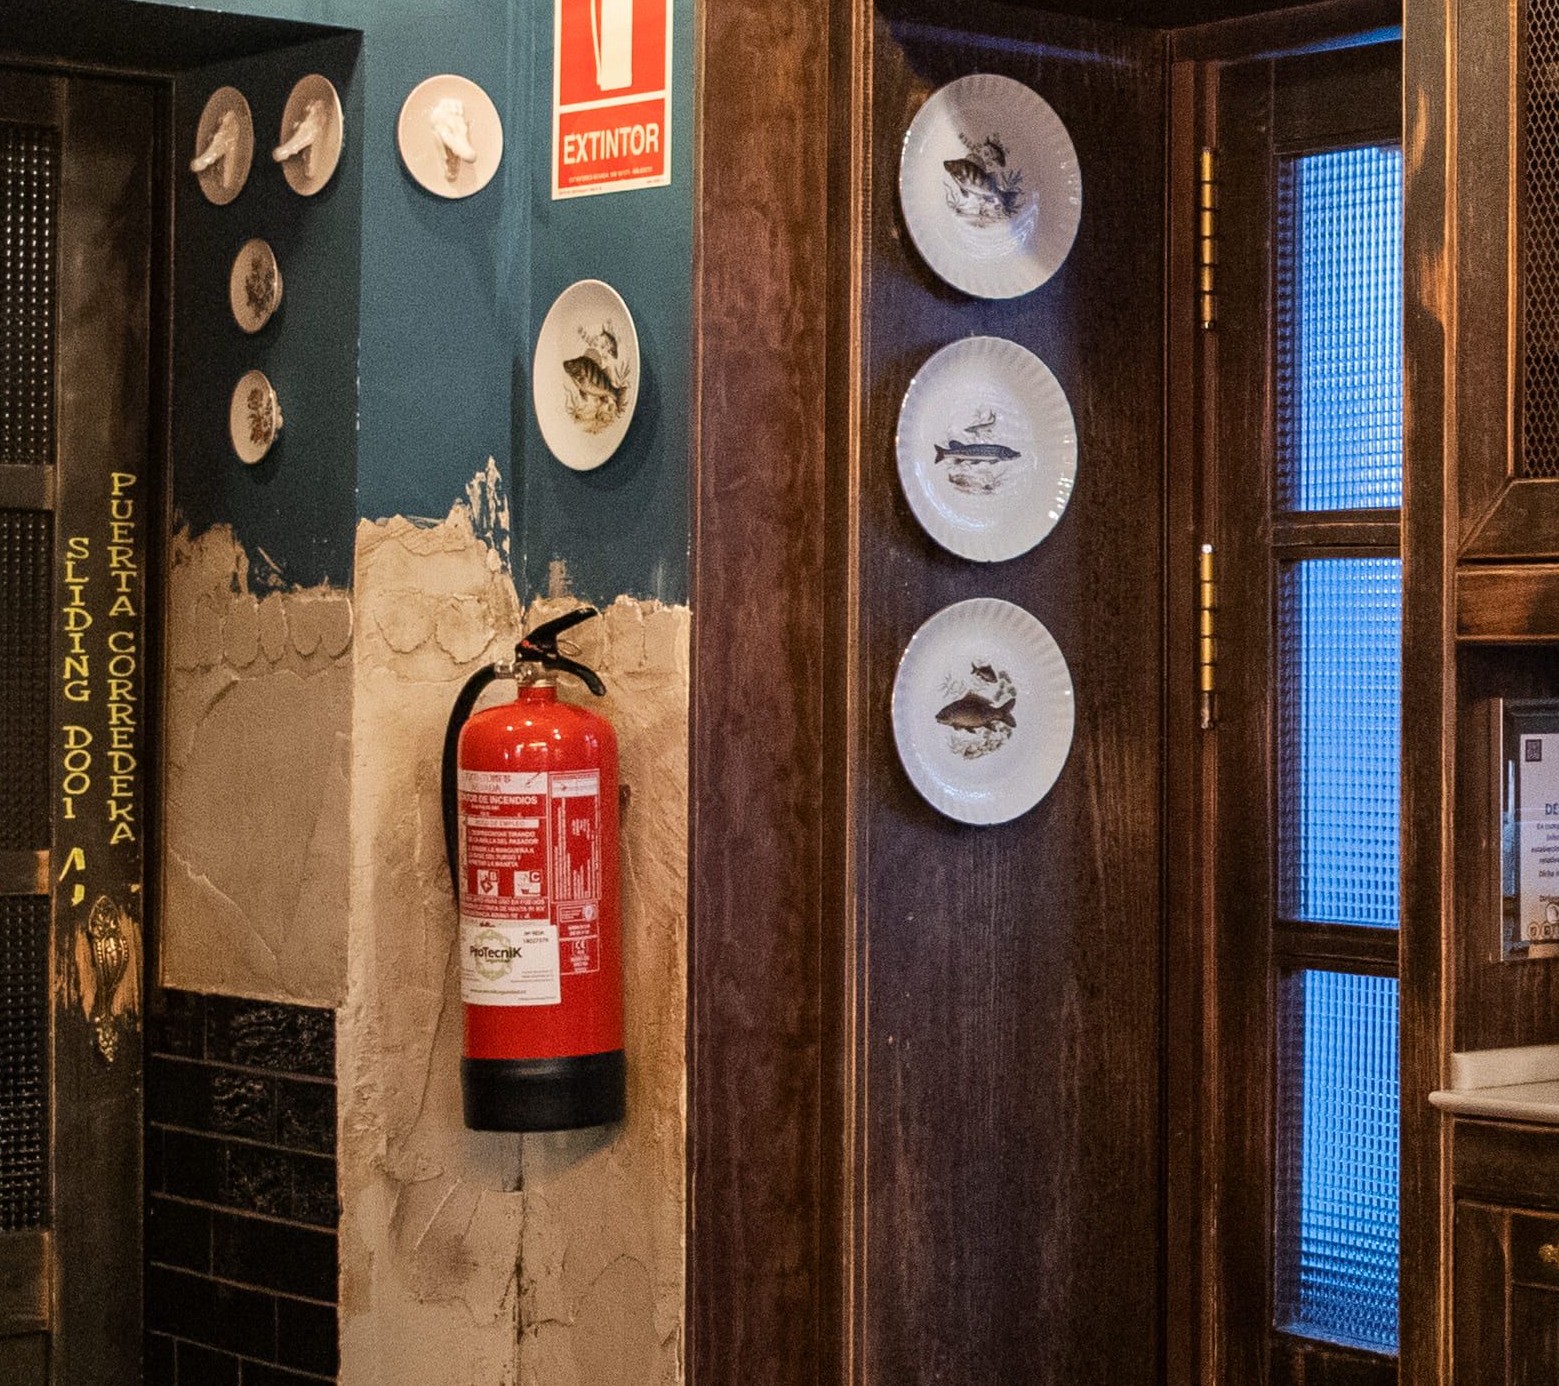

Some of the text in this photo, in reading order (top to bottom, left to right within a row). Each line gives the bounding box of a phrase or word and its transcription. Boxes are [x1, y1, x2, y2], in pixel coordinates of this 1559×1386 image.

[563, 122, 660, 165] EXTINTOR
[106, 471, 137, 616] PUERTA
[62, 536, 93, 702] SLIDING
[490, 795, 538, 805] INCENDIOS
[531, 872, 540, 881] C
